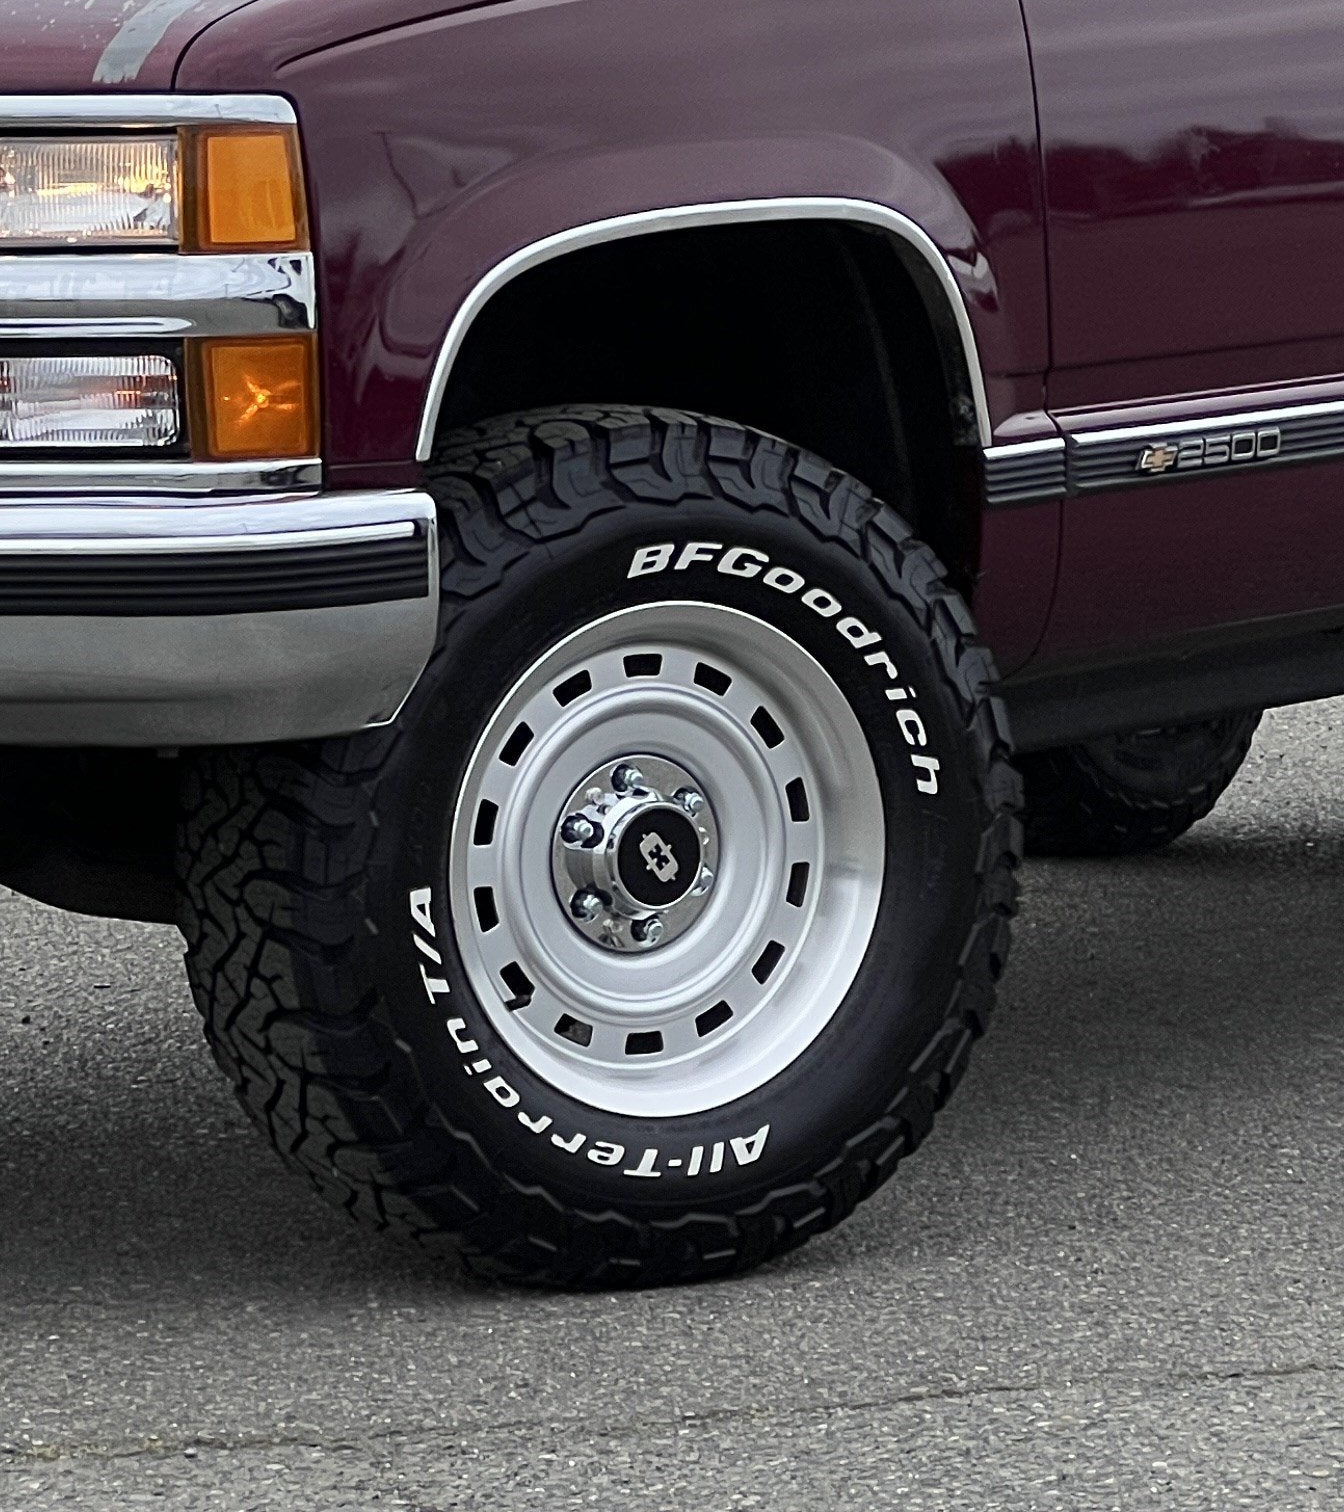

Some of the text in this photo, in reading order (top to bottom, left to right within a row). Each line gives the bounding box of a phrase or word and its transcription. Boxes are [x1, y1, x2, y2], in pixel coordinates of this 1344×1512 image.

[1176, 427, 1281, 468] 2500
[626, 542, 940, 796] BFGoodrich
[408, 886, 771, 1178] All-Terrain T/A
